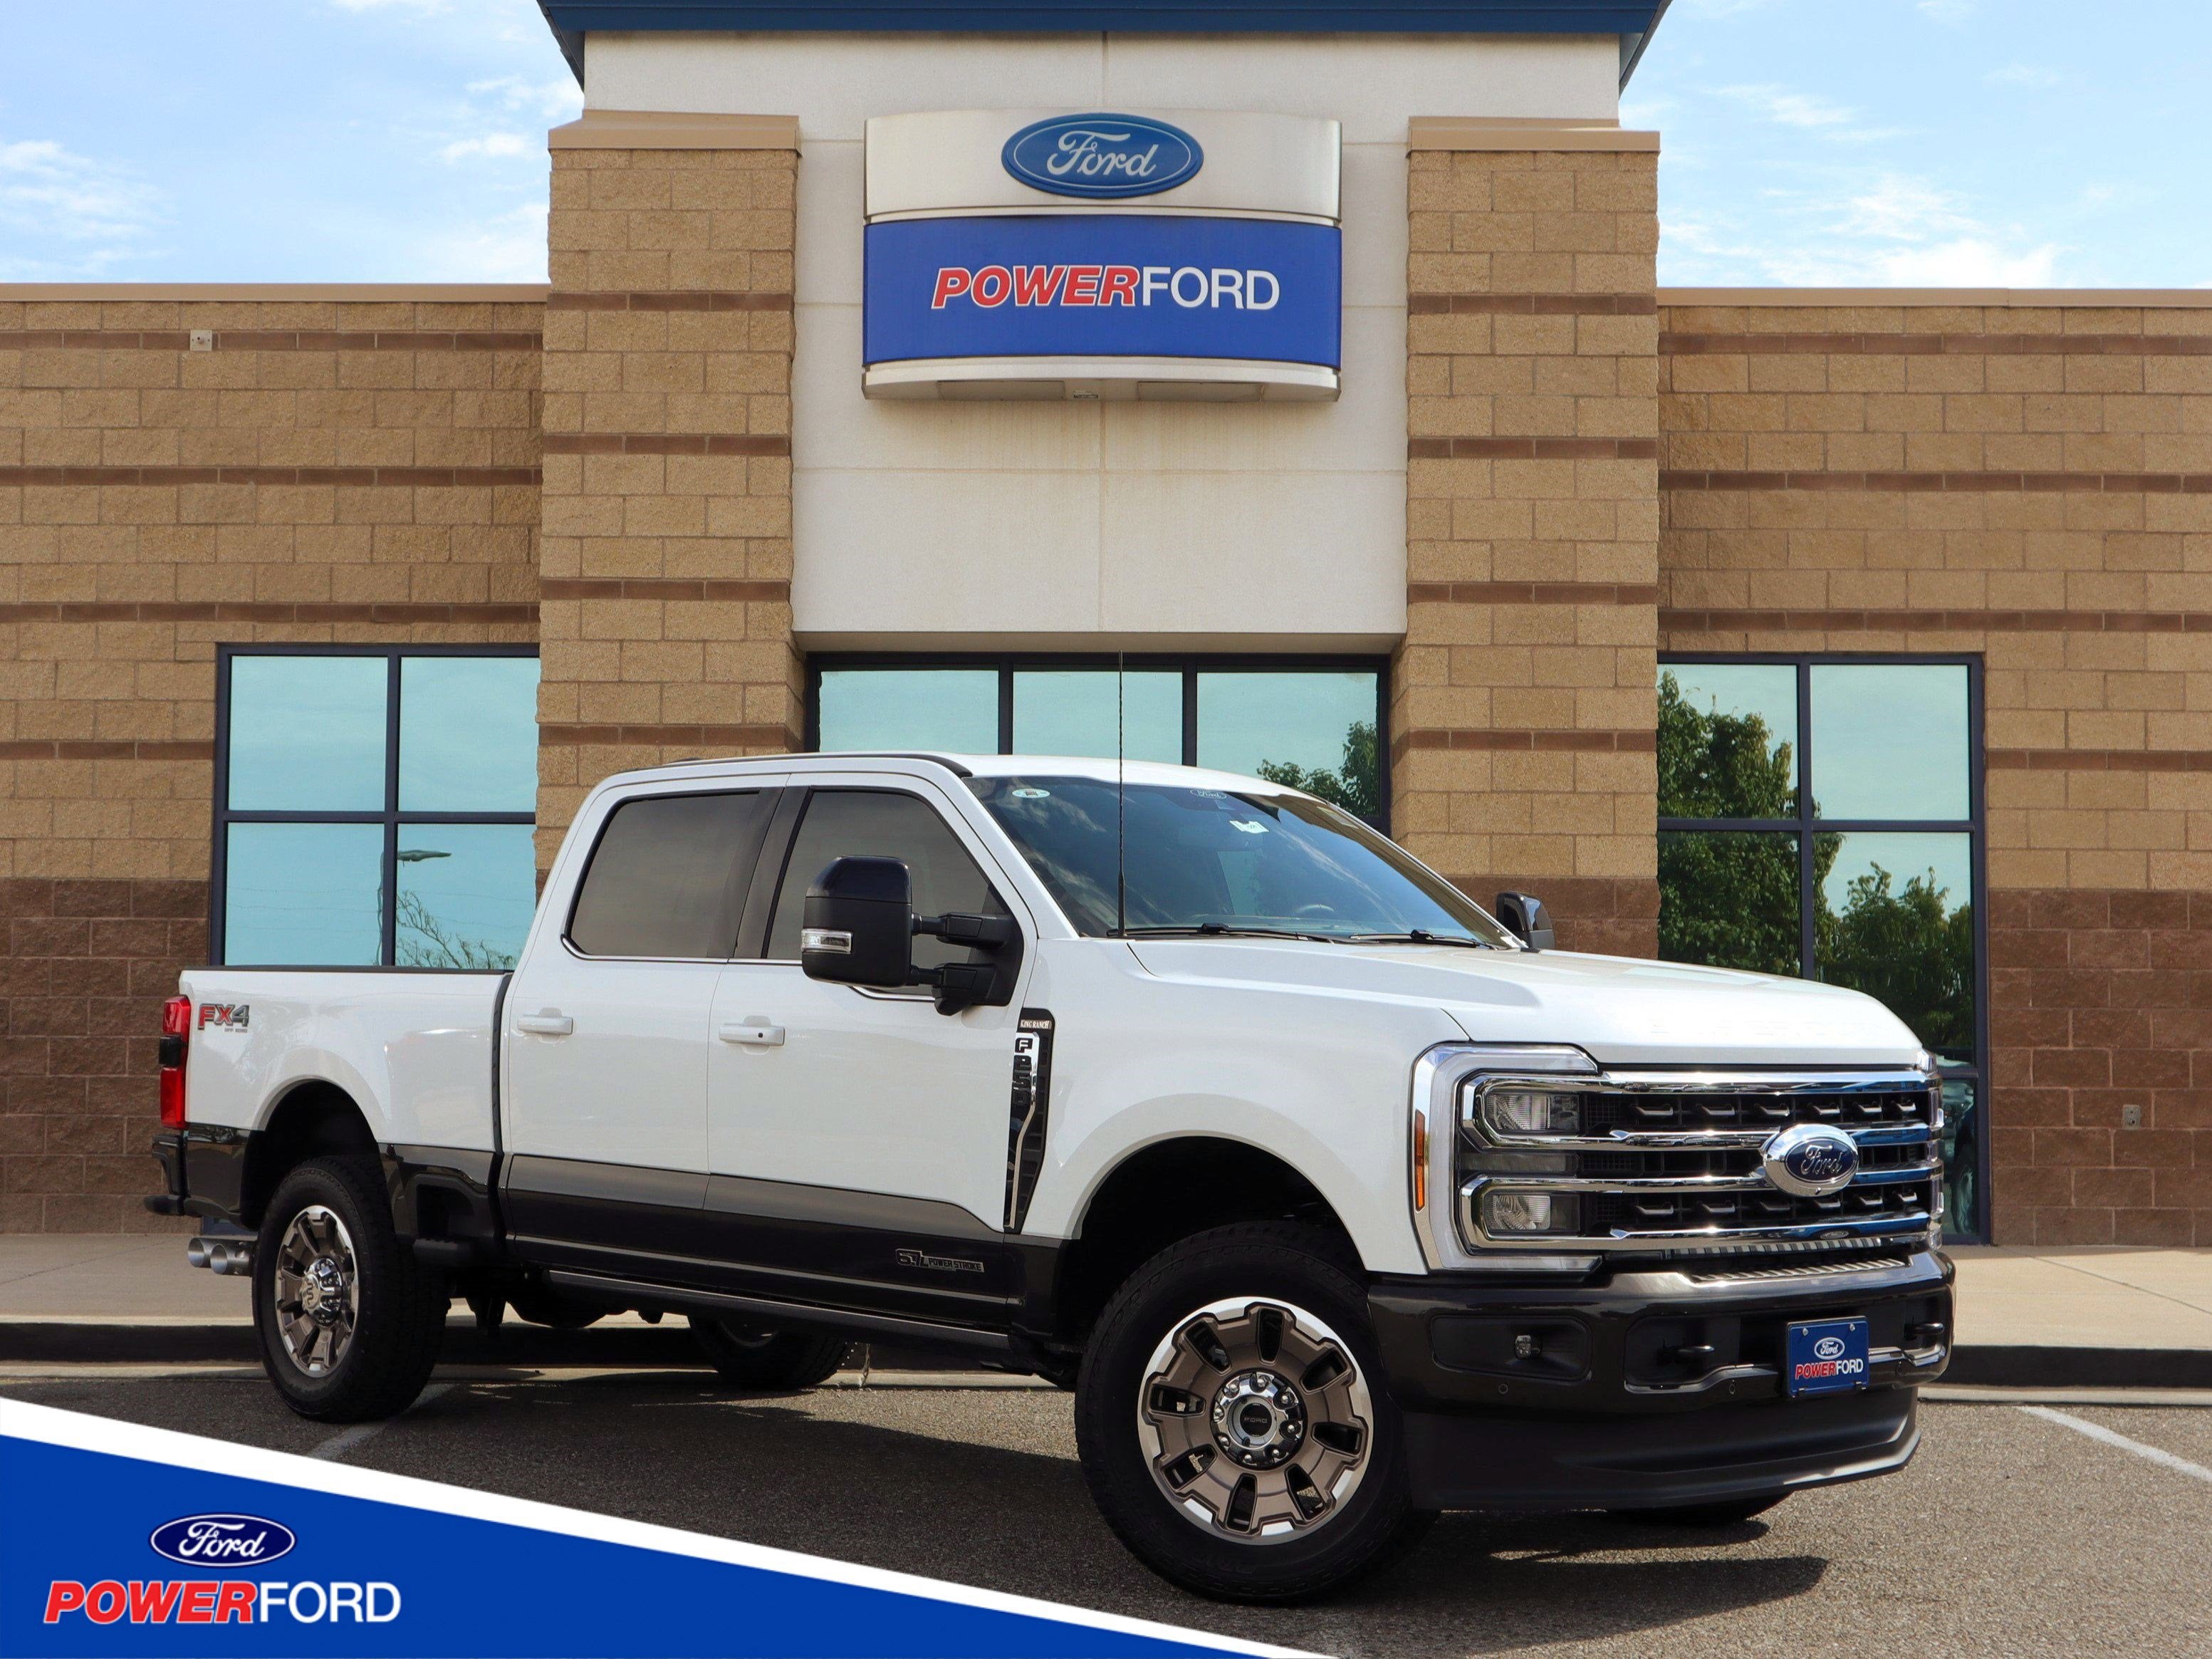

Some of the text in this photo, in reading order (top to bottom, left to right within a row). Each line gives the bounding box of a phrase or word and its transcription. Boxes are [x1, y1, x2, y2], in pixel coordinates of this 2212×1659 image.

[1046, 130, 1159, 177] Ford
[198, 1003, 249, 1031] FX4
[1020, 1019, 1050, 1029] KING RANCH
[1800, 1144, 1844, 1175] Ford
[929, 1257, 953, 1268] POWER
[954, 1260, 982, 1271] STROKE
[1820, 1341, 1839, 1355] Ford
